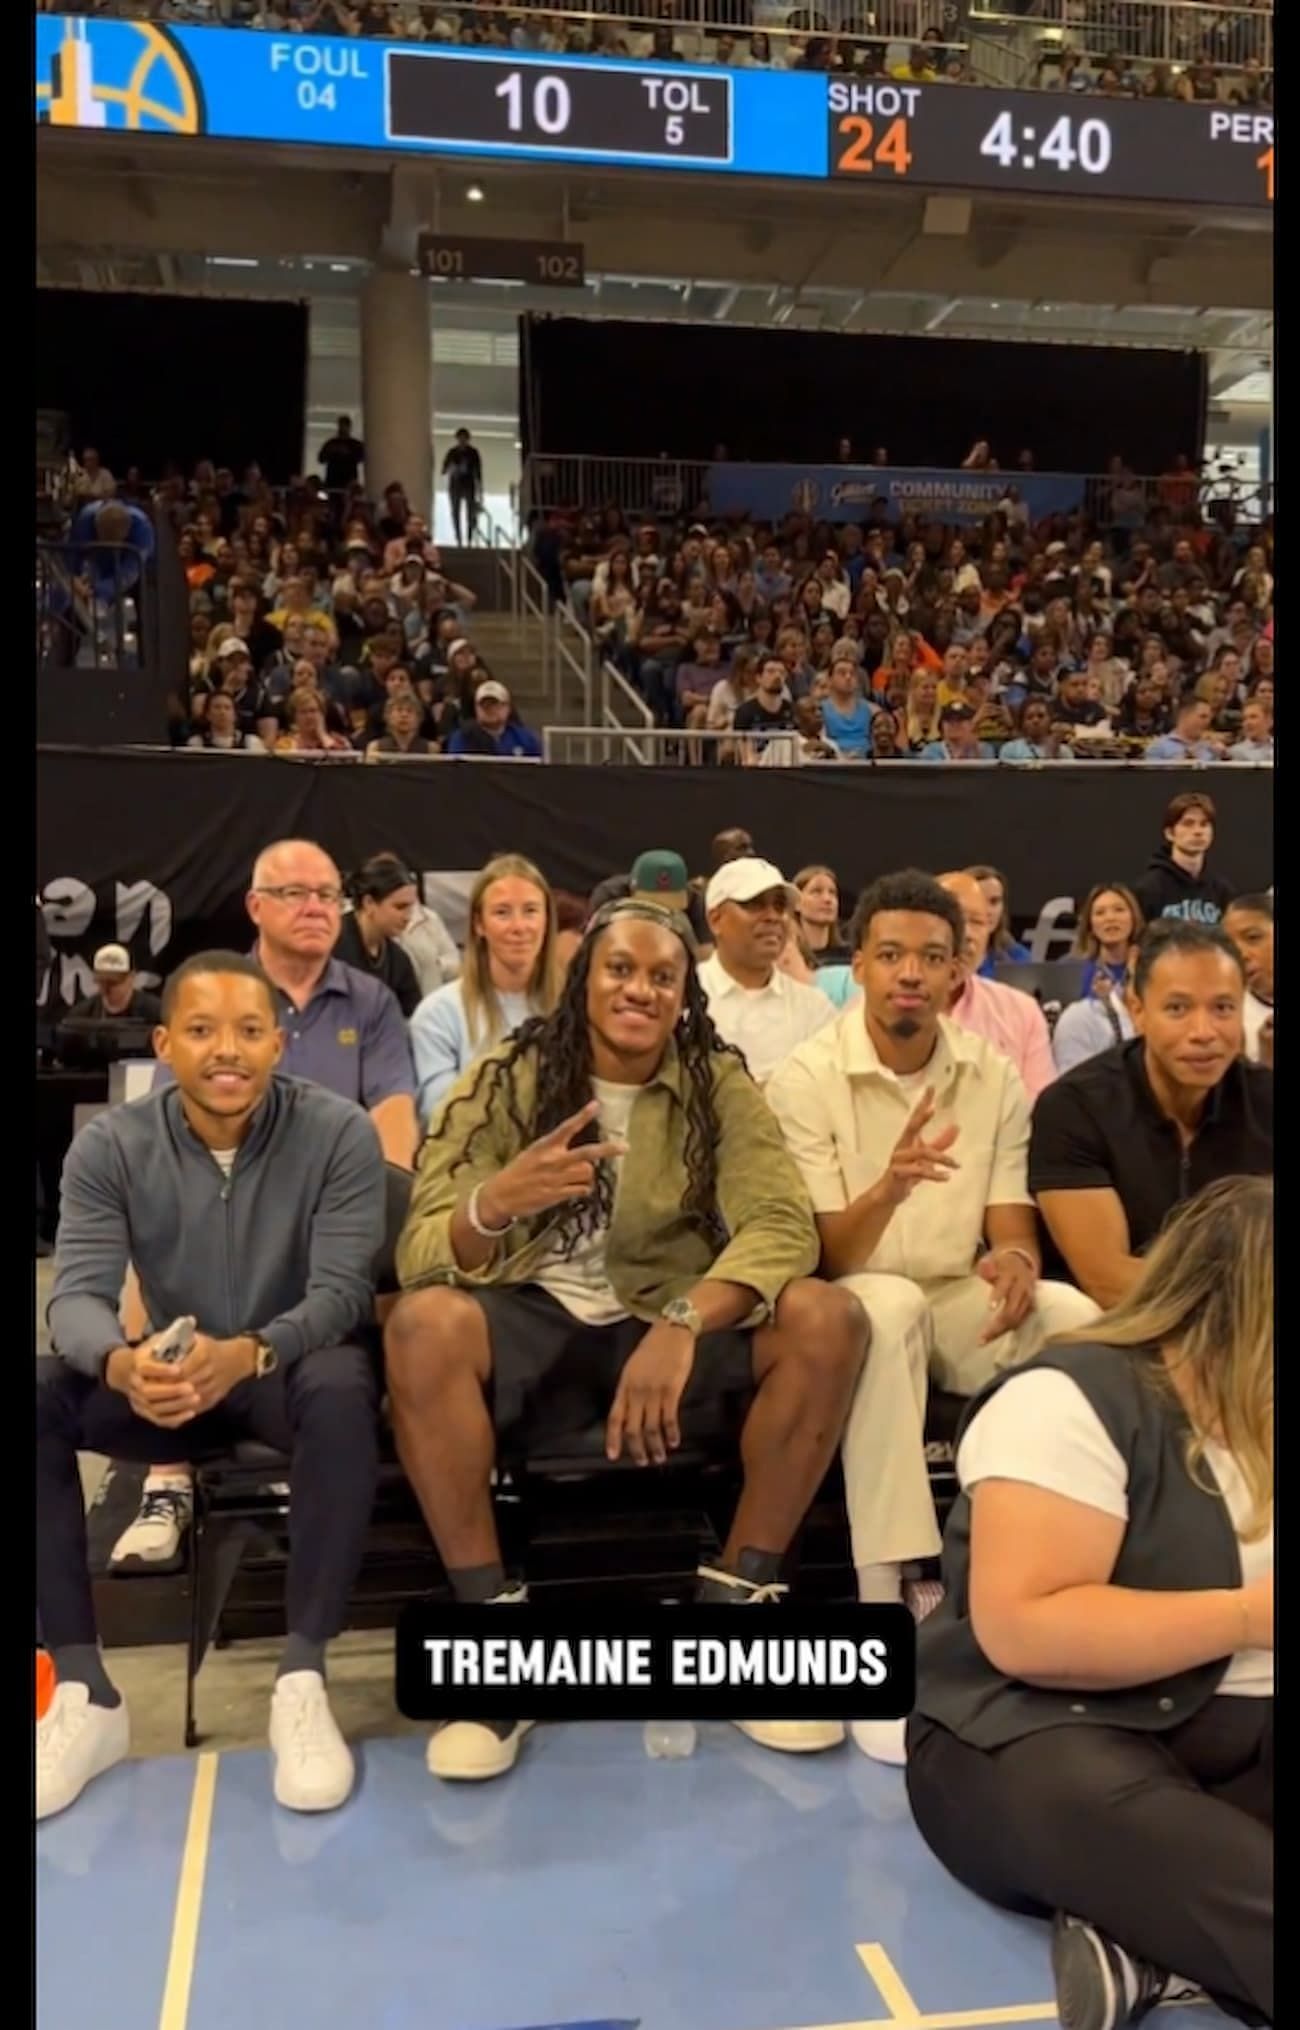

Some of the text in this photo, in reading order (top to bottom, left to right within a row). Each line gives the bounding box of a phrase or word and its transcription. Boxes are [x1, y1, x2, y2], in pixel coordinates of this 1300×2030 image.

[270, 42, 369, 78] FOUL
[298, 80, 336, 111] 04
[495, 71, 571, 134] 10
[641, 79, 710, 113] TOL
[828, 83, 921, 117] SHOT
[665, 115, 684, 145] 5
[838, 115, 912, 174] 24
[980, 111, 1112, 174] 4:40
[1210, 111, 1274, 144] PER
[1256, 146, 1274, 200] 1
[426, 250, 463, 272] 101
[538, 255, 578, 279] 102
[889, 481, 1009, 499] COMMUNITY
